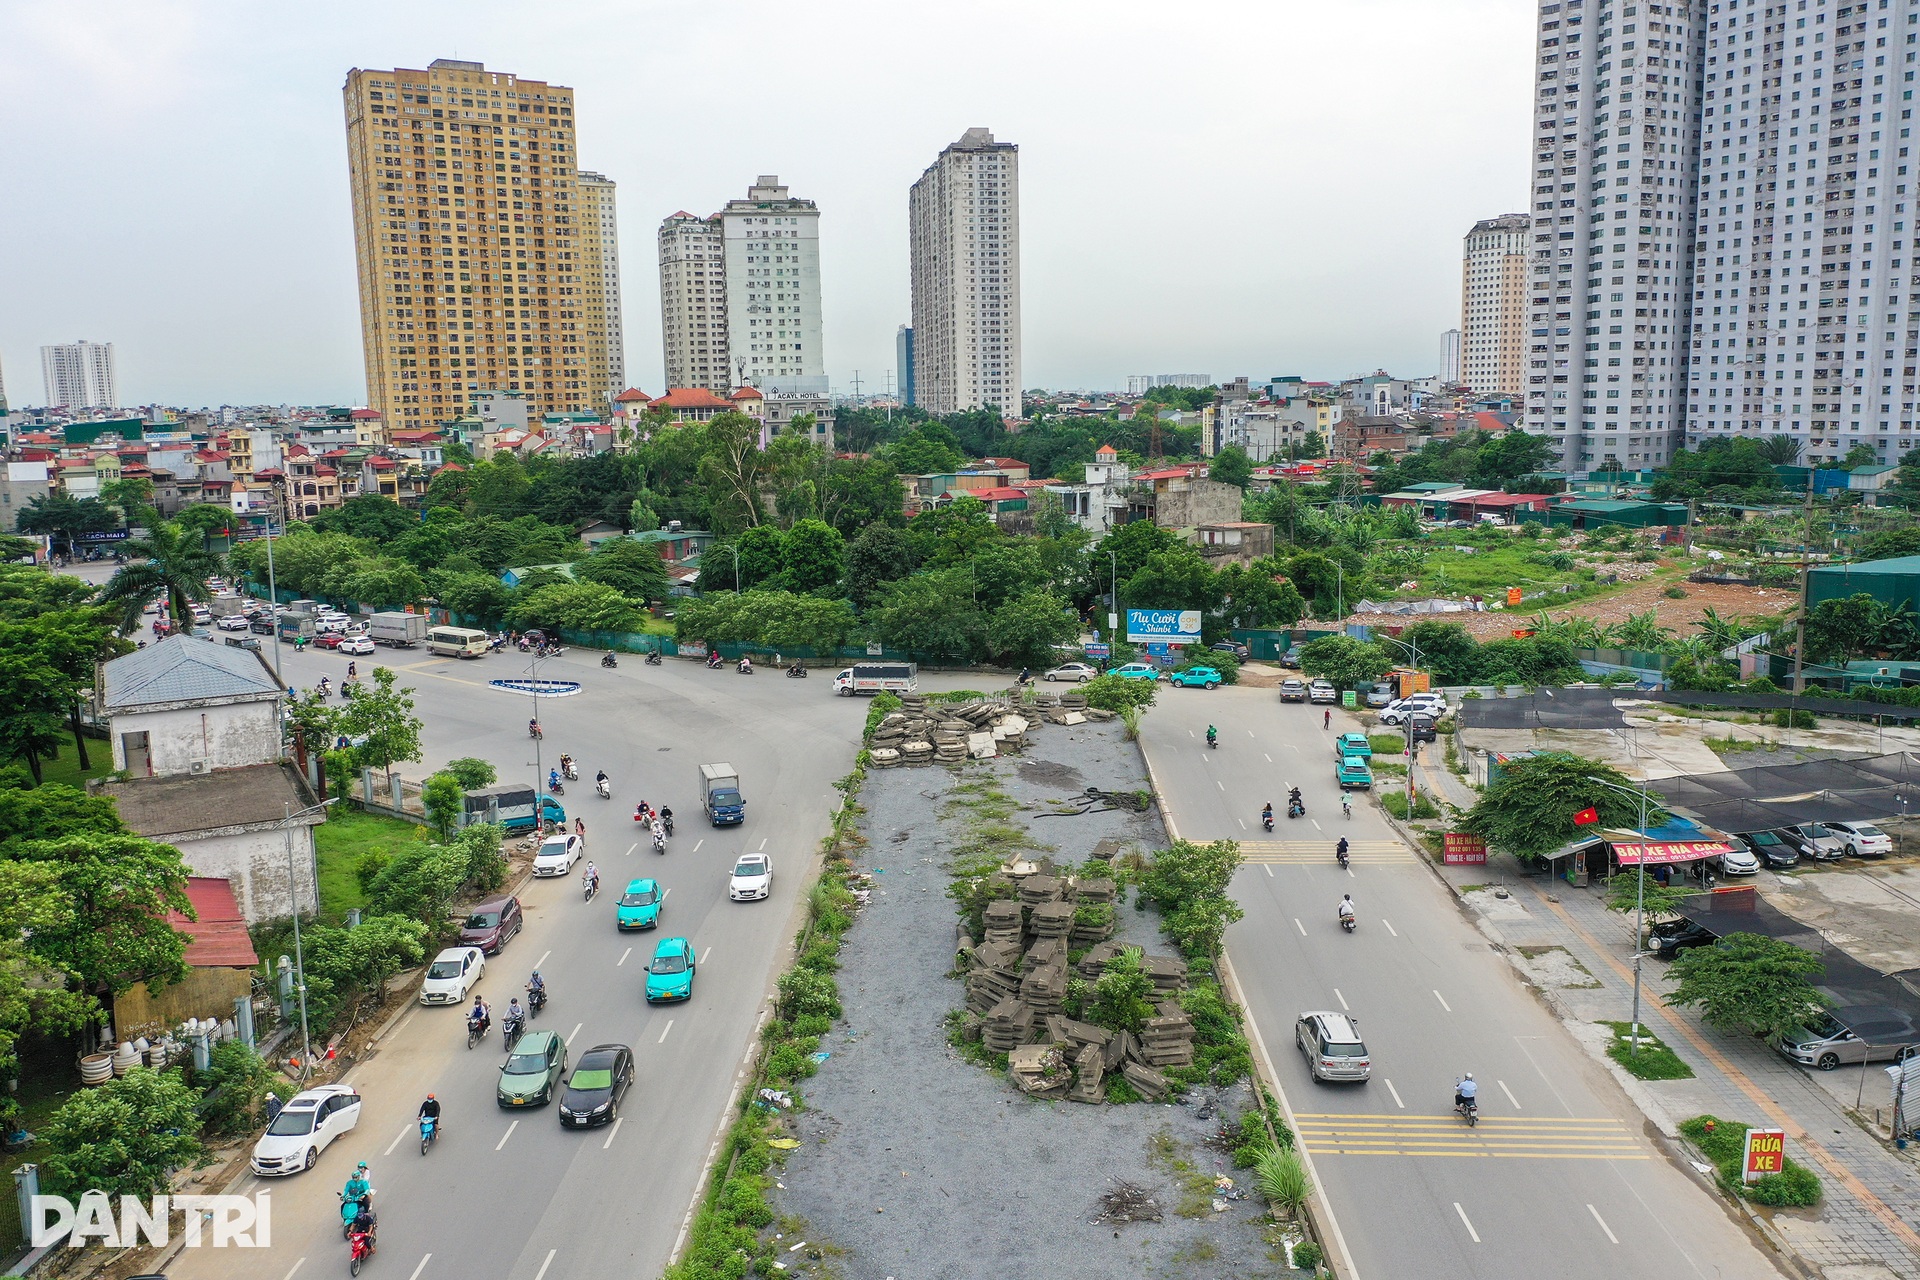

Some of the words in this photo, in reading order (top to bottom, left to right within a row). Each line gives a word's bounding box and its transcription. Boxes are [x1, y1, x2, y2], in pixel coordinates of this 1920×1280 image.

[1151, 612, 1177, 624] Cười
[1145, 623, 1171, 633] Shinbi
[1457, 837, 1464, 845] XE
[1616, 845, 1641, 857] BÃI
[1645, 846, 1667, 856] XE
[1750, 1133, 1781, 1153] RỬA
[1754, 1156, 1774, 1170] XE
